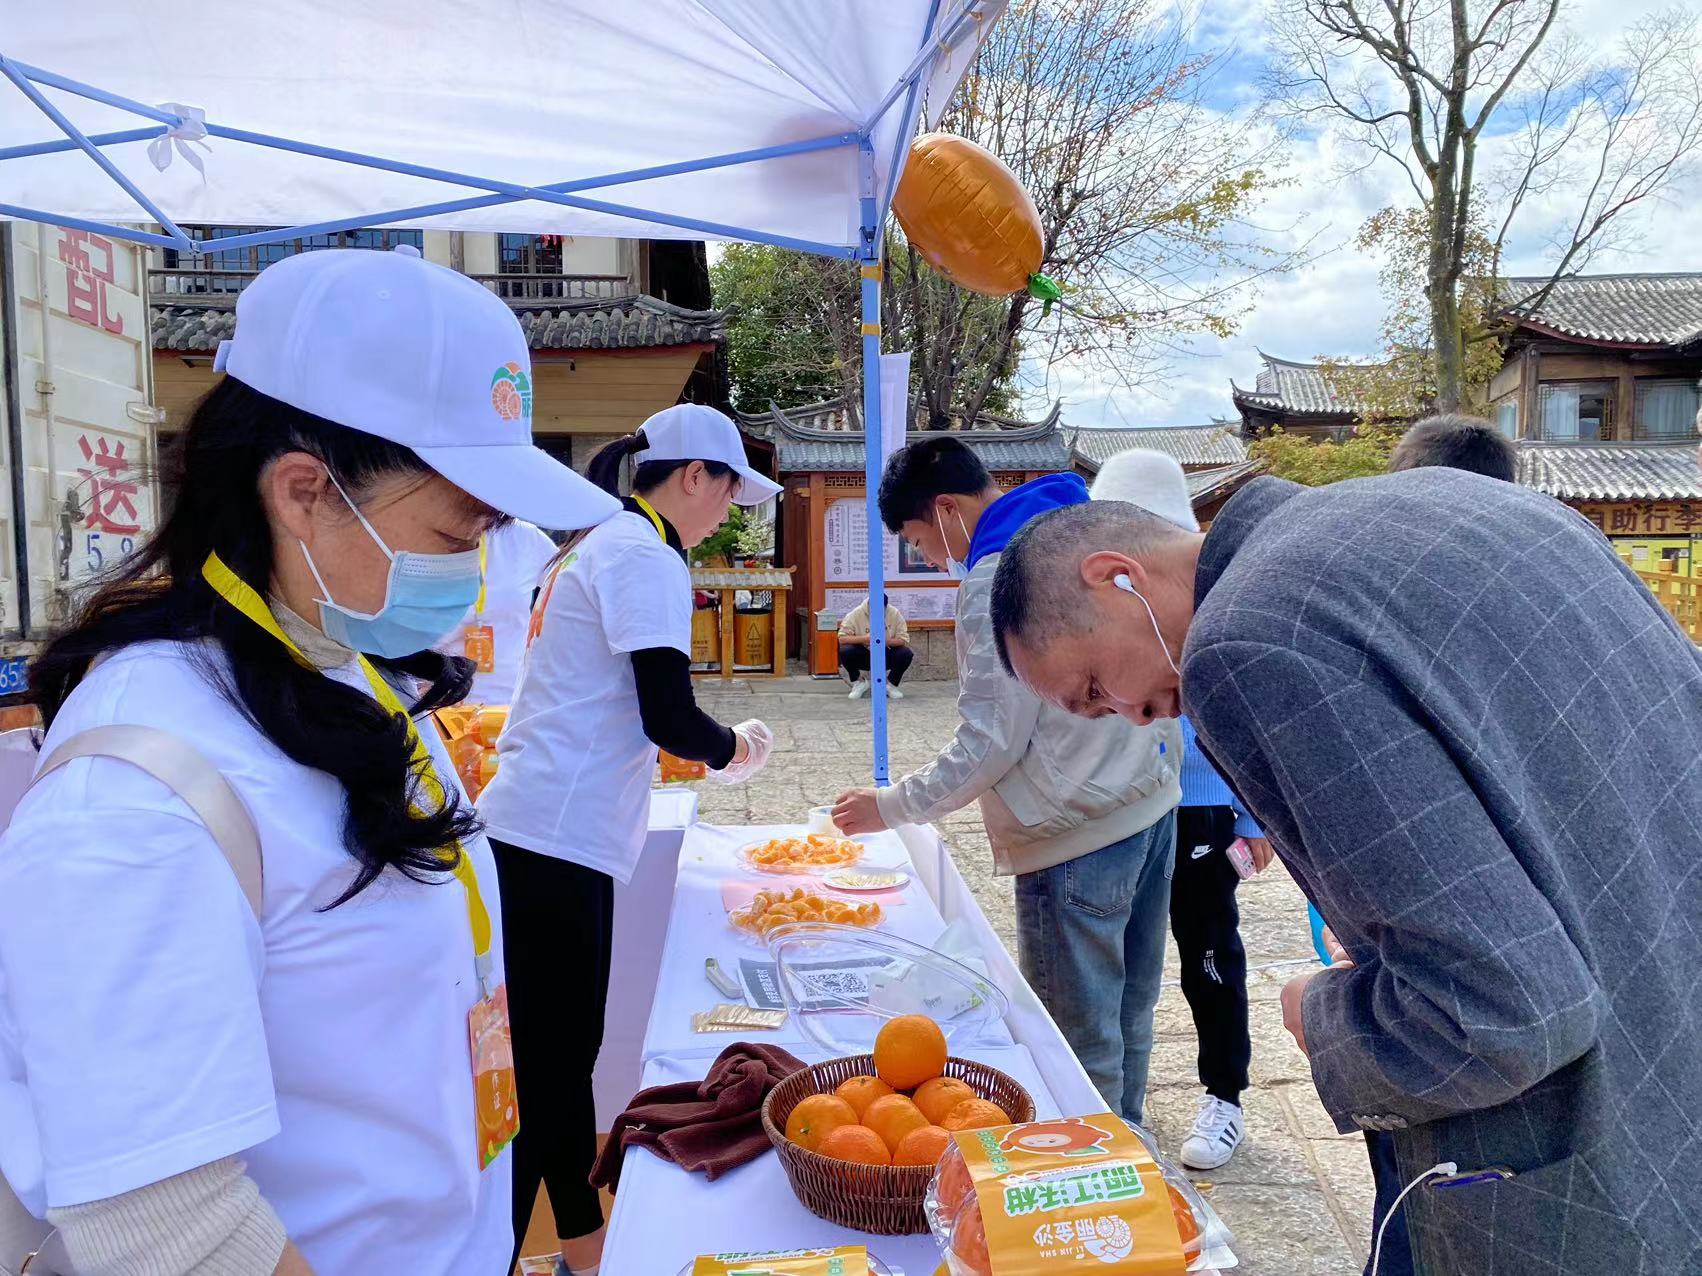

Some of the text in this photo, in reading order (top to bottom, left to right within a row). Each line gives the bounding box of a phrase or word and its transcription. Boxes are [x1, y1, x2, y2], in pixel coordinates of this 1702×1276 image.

[1006, 1165, 1142, 1214] 丽江沃柑
[1032, 1219, 1097, 1246] 丽金沙
